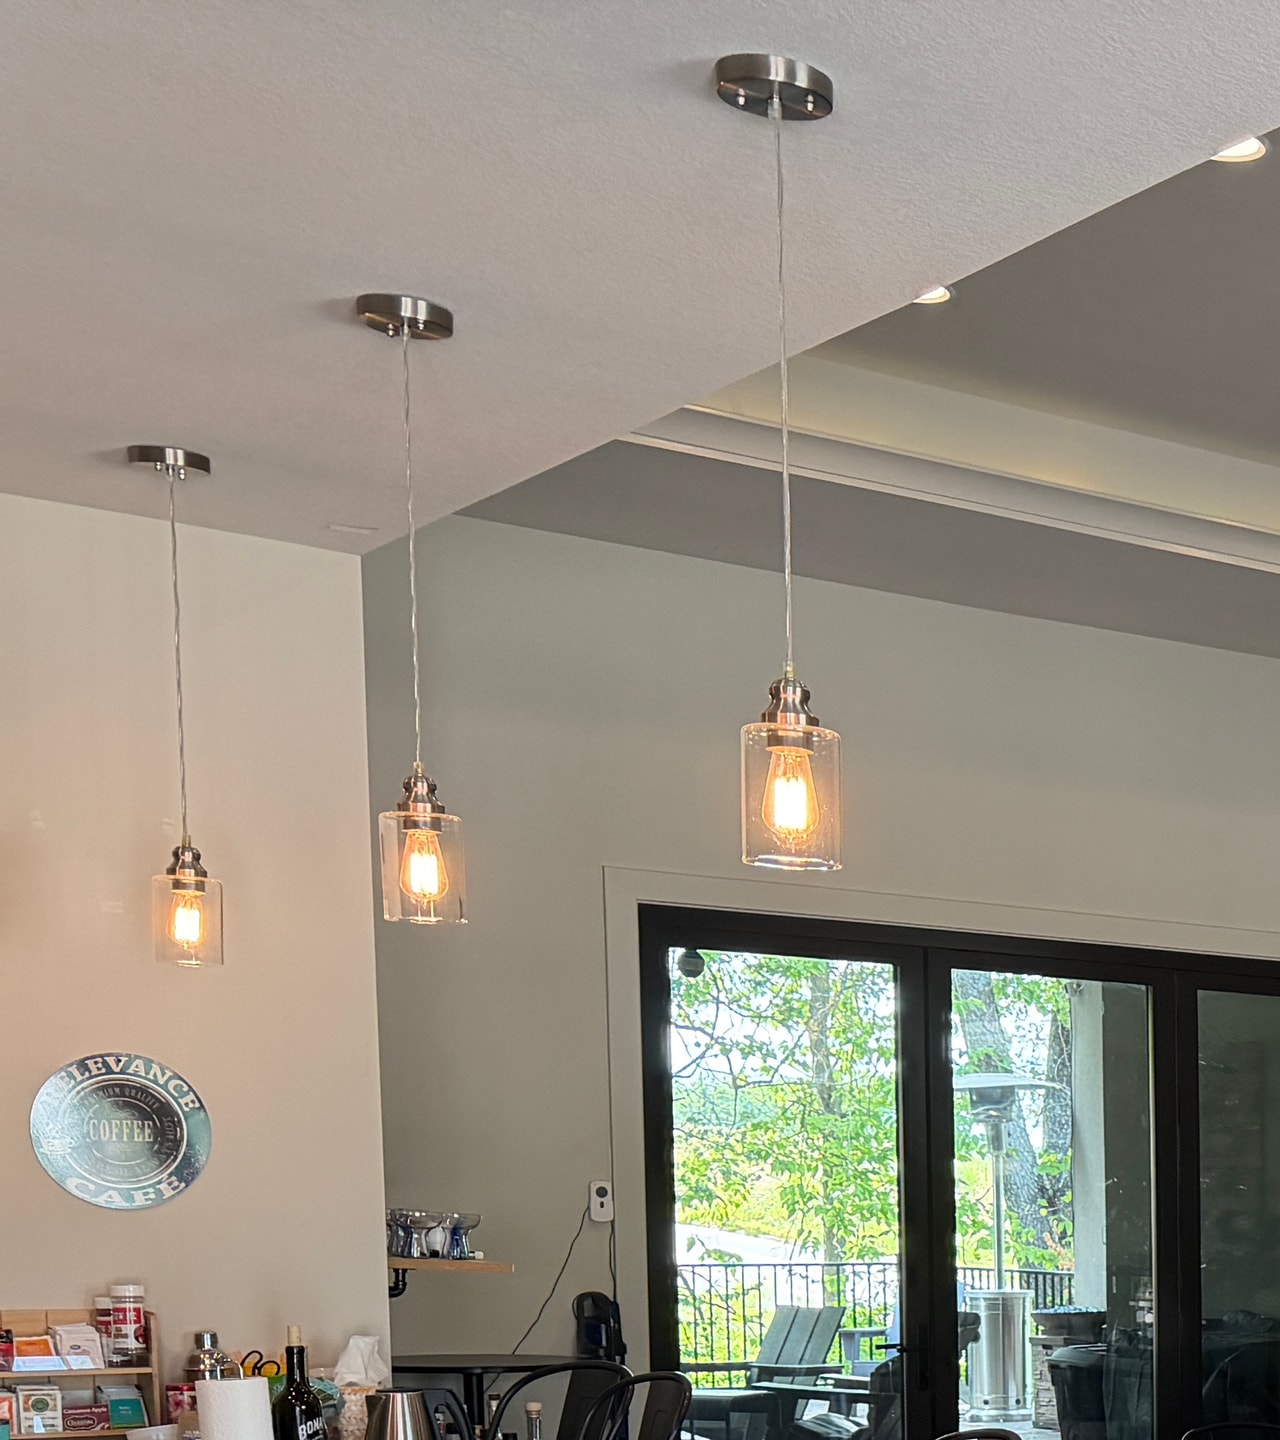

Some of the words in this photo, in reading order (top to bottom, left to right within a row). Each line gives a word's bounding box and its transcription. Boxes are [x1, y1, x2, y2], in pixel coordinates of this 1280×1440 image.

[39, 1056, 201, 1112] RELEVANCE
[89, 1119, 154, 1142] COFFEE
[65, 1174, 186, 1207] CAFÉ
